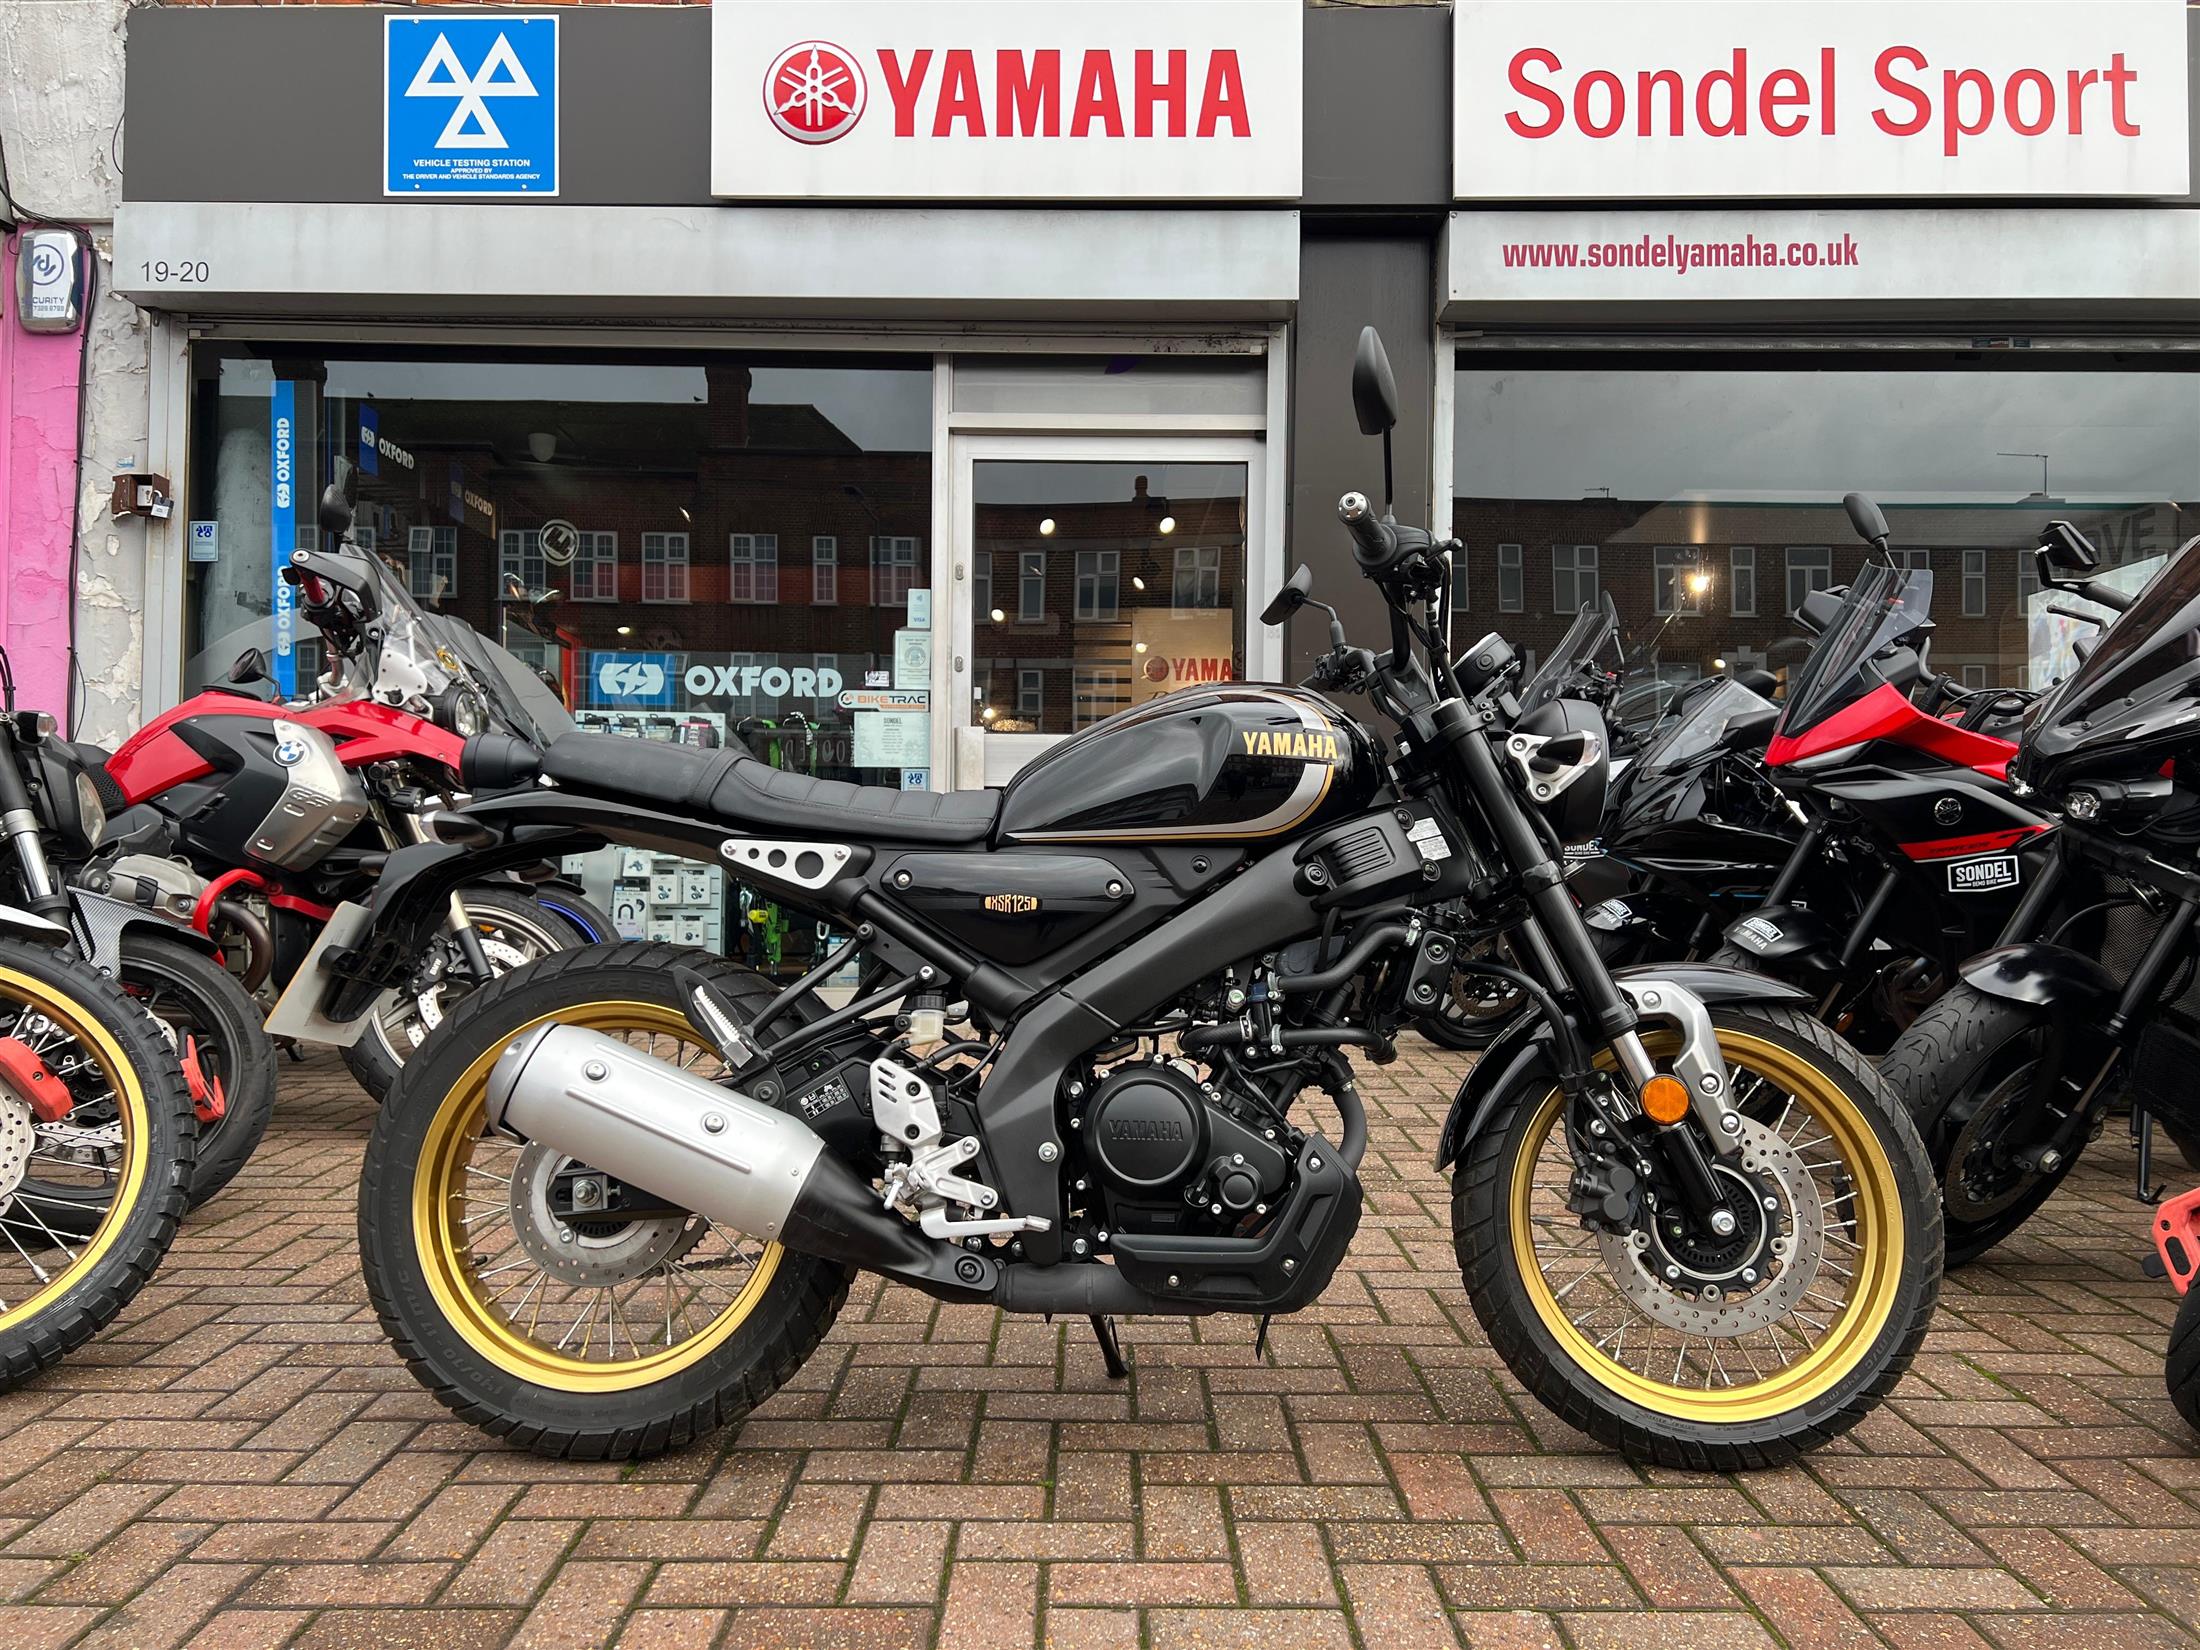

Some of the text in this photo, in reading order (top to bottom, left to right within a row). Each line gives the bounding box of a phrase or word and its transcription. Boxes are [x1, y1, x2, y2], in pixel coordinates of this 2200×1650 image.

[876, 48, 1252, 139] YAMAHA
[1503, 45, 2141, 157] Sondel Sport
[413, 159, 530, 167] VEHICLE TESTING STATION
[1502, 233, 1859, 274] www.sondelyamaha.co.uk
[141, 261, 209, 283] 19-20
[276, 417, 290, 482] OXFORD
[378, 438, 415, 470] OXFORD
[464, 489, 493, 517] OXFORD
[684, 665, 843, 698] OXFORD
[857, 695, 926, 704] BIKETRAC
[1242, 731, 1338, 760] YAMAHA
[1955, 861, 2012, 882] SONDEL
[991, 894, 1031, 913] XSR125
[1109, 1119, 1184, 1142] YAMAHA
